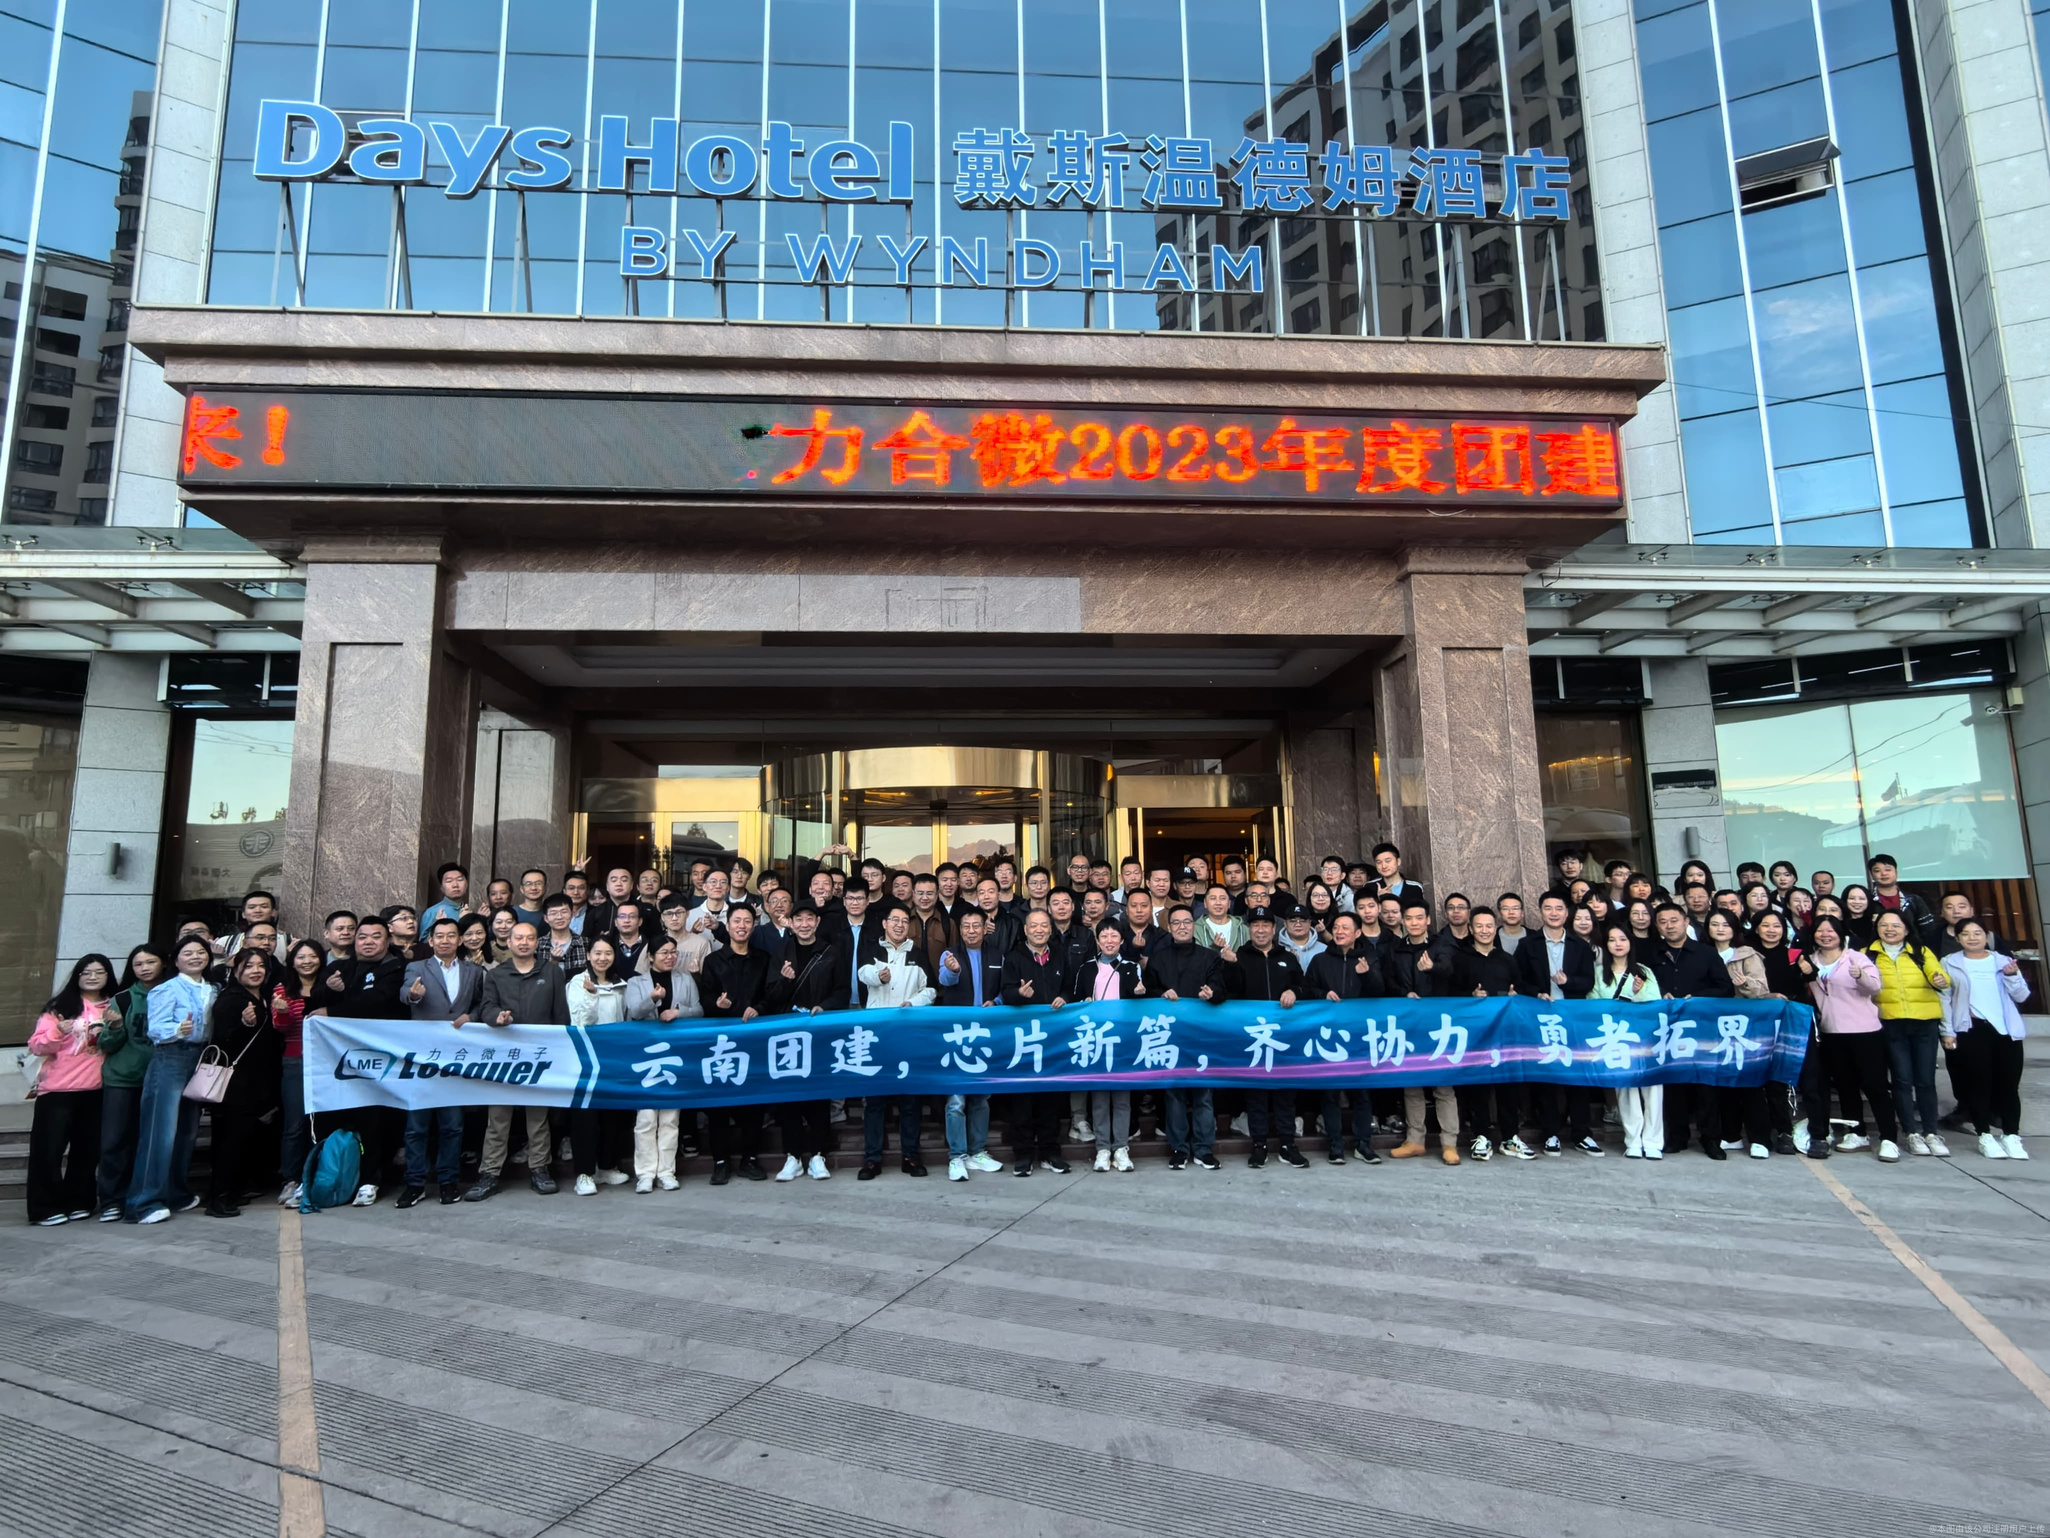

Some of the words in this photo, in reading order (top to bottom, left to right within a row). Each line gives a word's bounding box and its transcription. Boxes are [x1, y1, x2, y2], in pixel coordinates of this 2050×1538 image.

[253, 98, 573, 198] Days
[598, 114, 914, 200] Hotel
[953, 127, 1572, 222] 戴斯温德姆酒店
[620, 226, 737, 279] BY
[785, 233, 1264, 293] WYNDHAM
[770, 408, 1619, 497] 力合微2023年度团建
[347, 1058, 382, 1070] LME
[426, 1047, 548, 1061] 力合微电子
